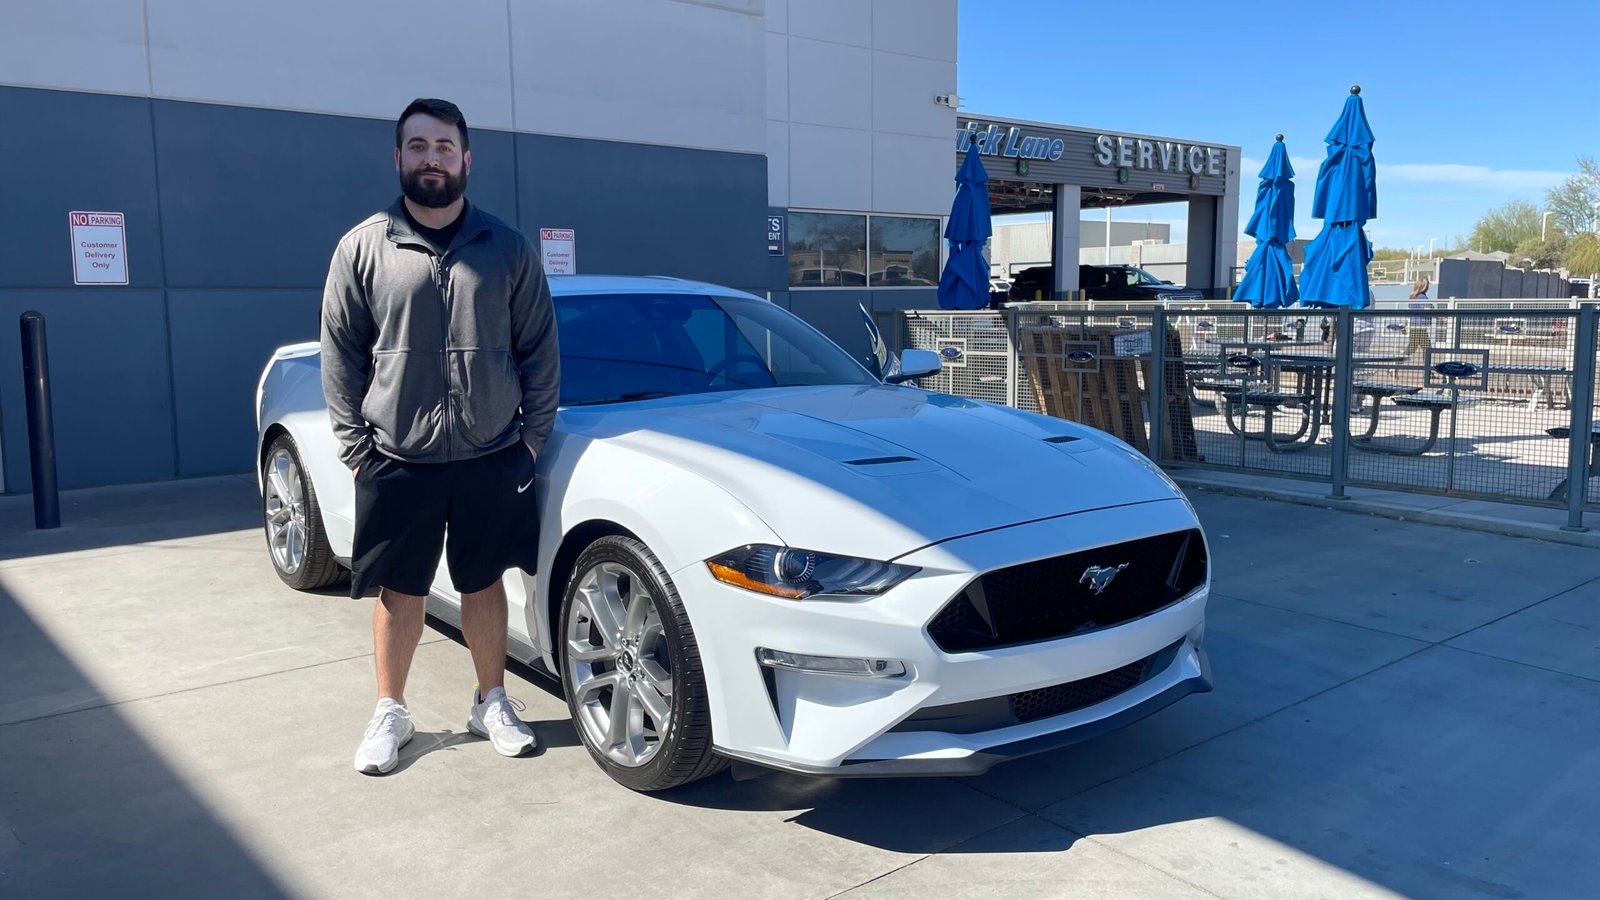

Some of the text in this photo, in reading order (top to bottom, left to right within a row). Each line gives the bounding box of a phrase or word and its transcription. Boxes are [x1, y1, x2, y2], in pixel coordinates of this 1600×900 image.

[1004, 126, 1065, 161] Lane
[1094, 134, 1220, 175] SERVICE
[72, 214, 121, 225] NO PARKING
[542, 230, 573, 240] NO PARKING
[80, 241, 118, 249] Customer
[85, 251, 115, 260] Delivery
[92, 261, 110, 270] Only
